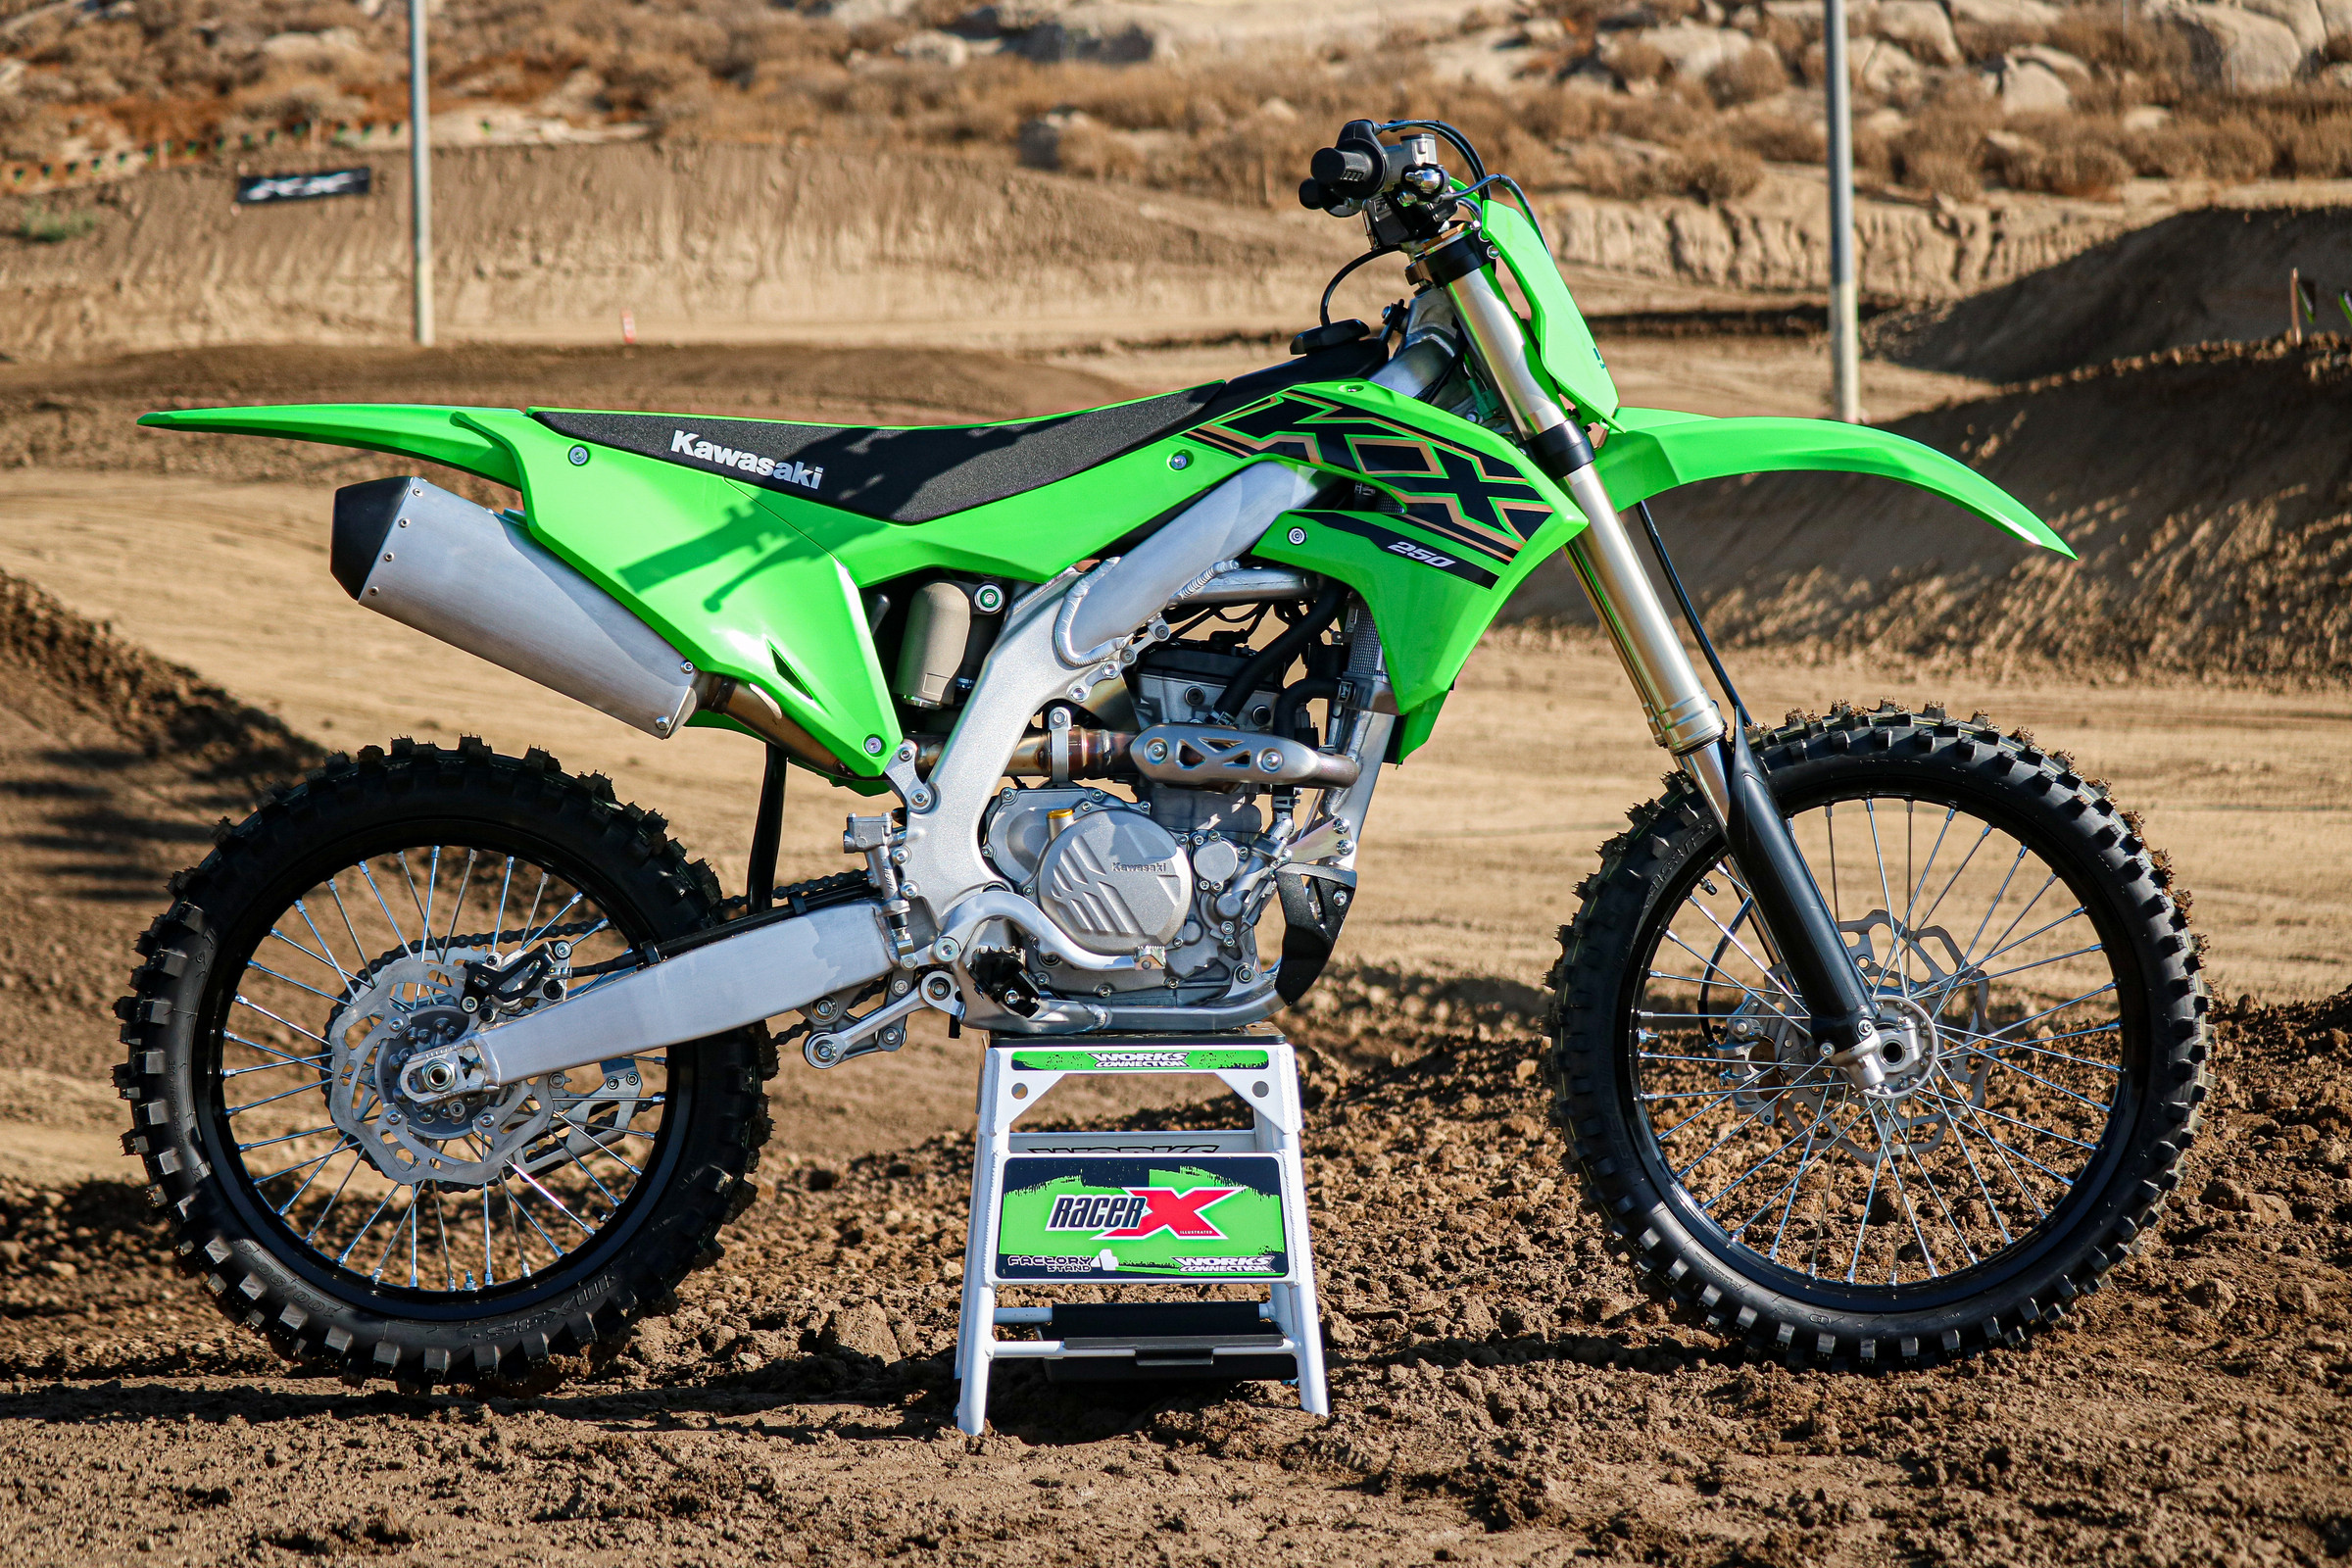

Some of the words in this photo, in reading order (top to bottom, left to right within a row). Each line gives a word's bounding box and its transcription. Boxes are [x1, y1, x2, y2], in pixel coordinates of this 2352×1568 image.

[671, 430, 824, 490] Kawasaki
[1387, 541, 1456, 567] 250
[1111, 861, 1166, 872] Kawasaki
[1086, 1052, 1191, 1061] WORKS
[1092, 1187, 1247, 1240] X
[1171, 1255, 1275, 1266] WORKS
[1046, 1264, 1091, 1273] STAND
